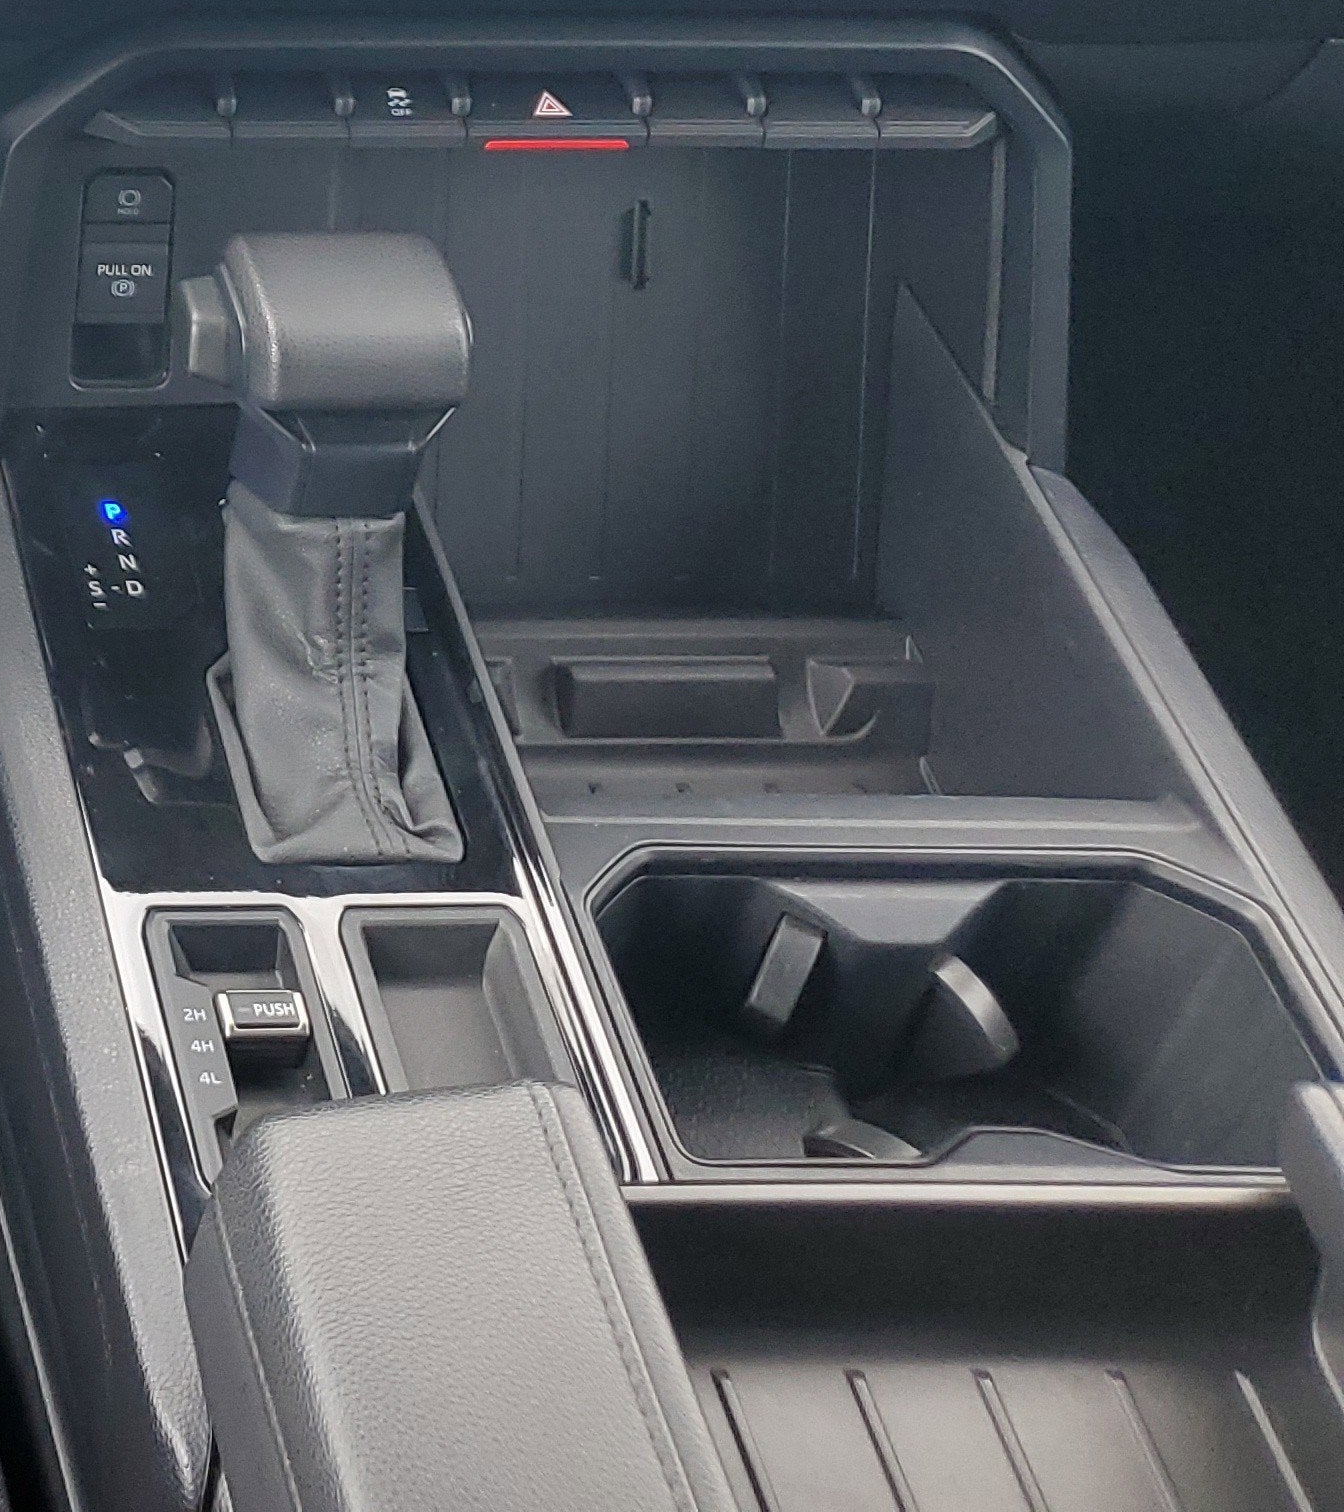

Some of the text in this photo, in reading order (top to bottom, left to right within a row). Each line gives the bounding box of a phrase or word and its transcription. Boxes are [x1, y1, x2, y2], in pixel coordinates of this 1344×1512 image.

[390, 107, 413, 117] OFF
[97, 264, 154, 277] PULL ON
[104, 502, 122, 521] P
[111, 528, 133, 548] R
[118, 554, 140, 572] N
[88, 580, 107, 599] S
[125, 580, 145, 599] D
[183, 1008, 208, 1023] 2H
[253, 1002, 296, 1018] PUSH
[190, 1040, 216, 1053] 4H
[198, 1071, 224, 1085] 4L
